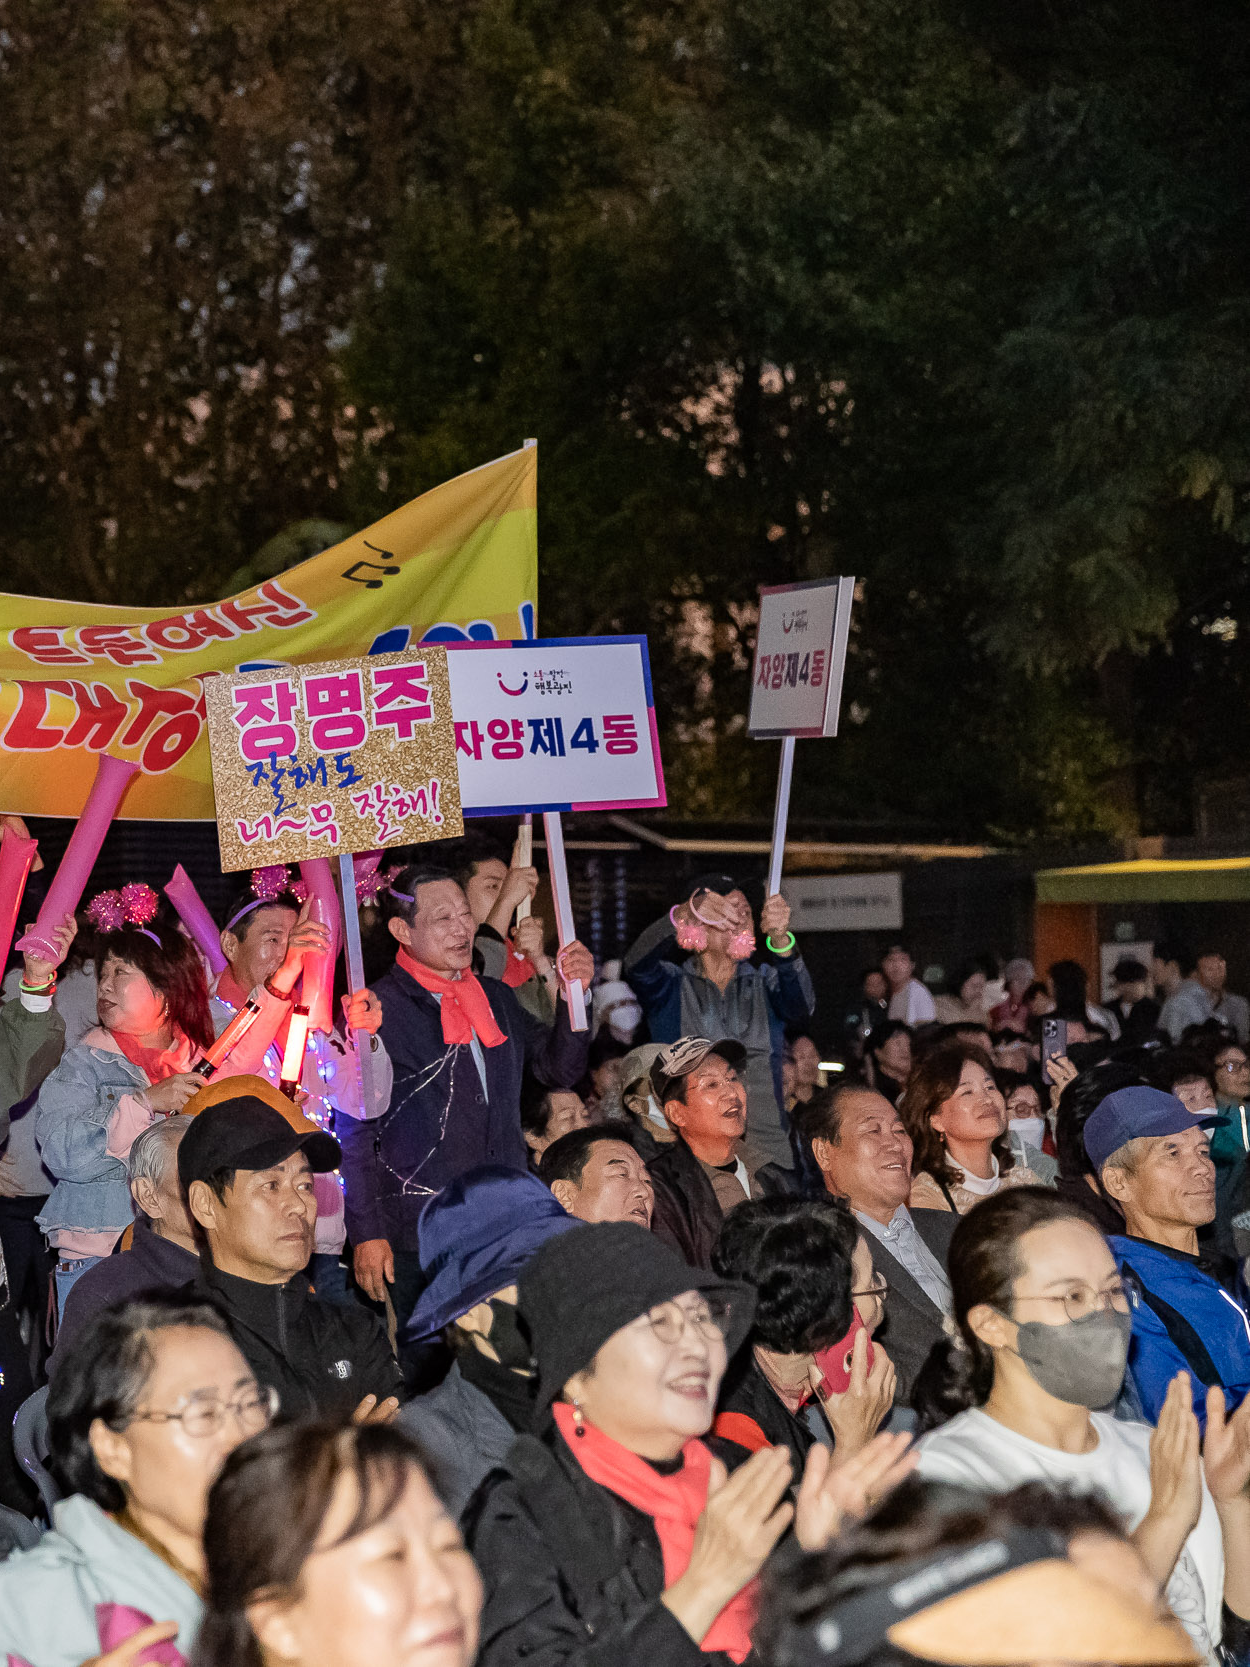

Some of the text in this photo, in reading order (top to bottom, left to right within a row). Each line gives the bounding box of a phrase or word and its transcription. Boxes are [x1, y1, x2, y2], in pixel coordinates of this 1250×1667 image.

[534, 680, 572, 695] 행복광진
[757, 650, 825, 690] 자양제4동
[232, 662, 434, 762] 장명주
[453, 714, 639, 760] 자양제4동
[245, 751, 364, 816] 잘해도
[236, 779, 444, 845] 너~무 잘해!
